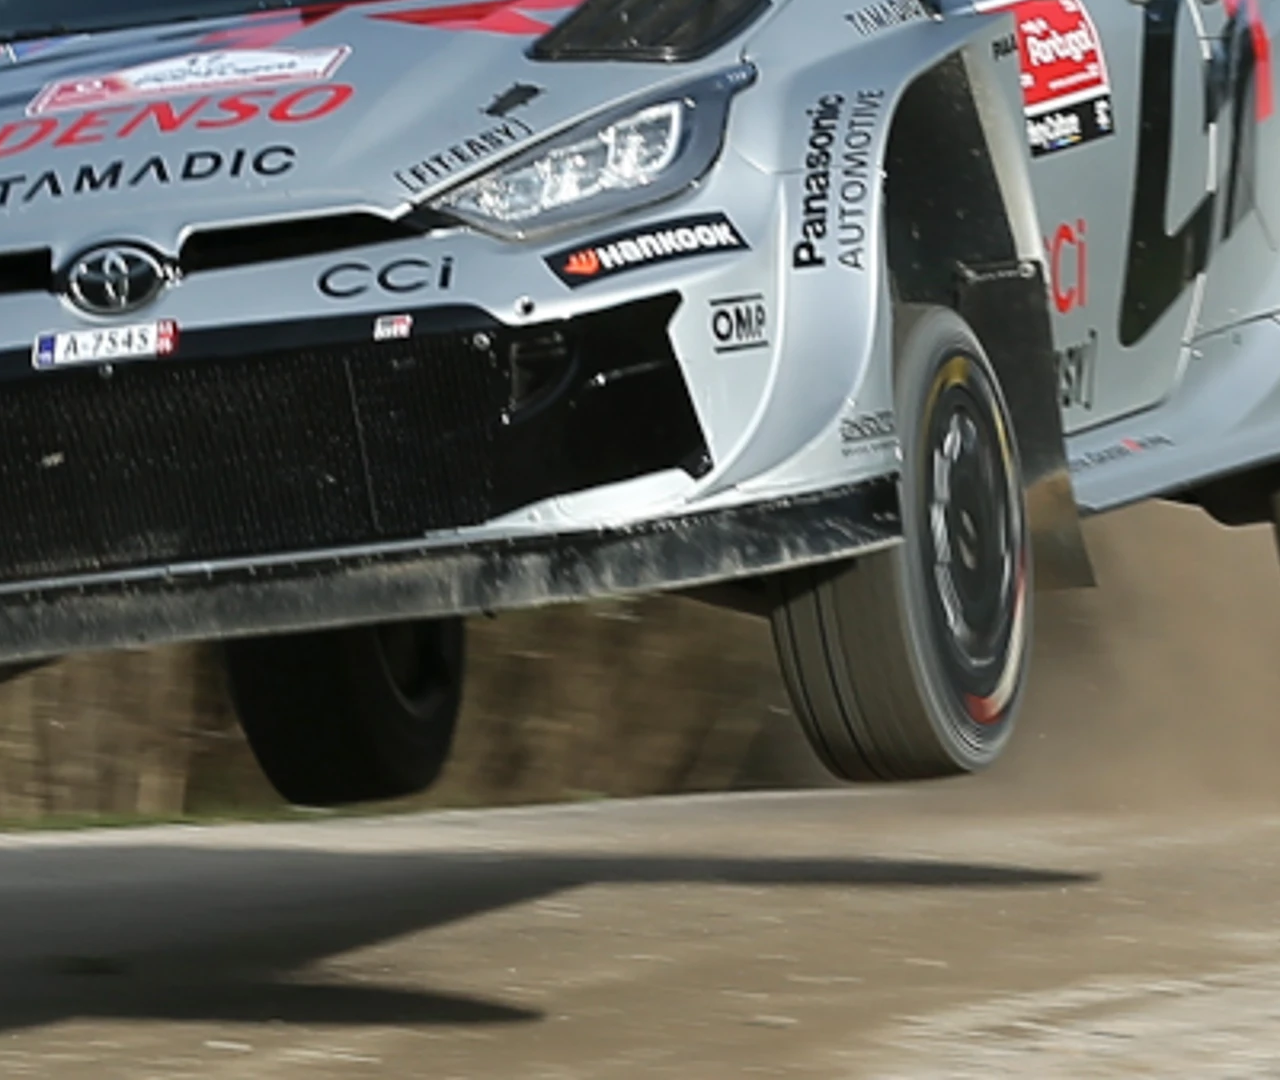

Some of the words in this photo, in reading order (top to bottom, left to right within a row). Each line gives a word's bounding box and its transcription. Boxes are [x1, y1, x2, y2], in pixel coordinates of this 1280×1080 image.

[792, 93, 846, 269] Panasonic
[837, 88, 885, 271] AUTOMOTIVE
[712, 305, 766, 341] OMP
